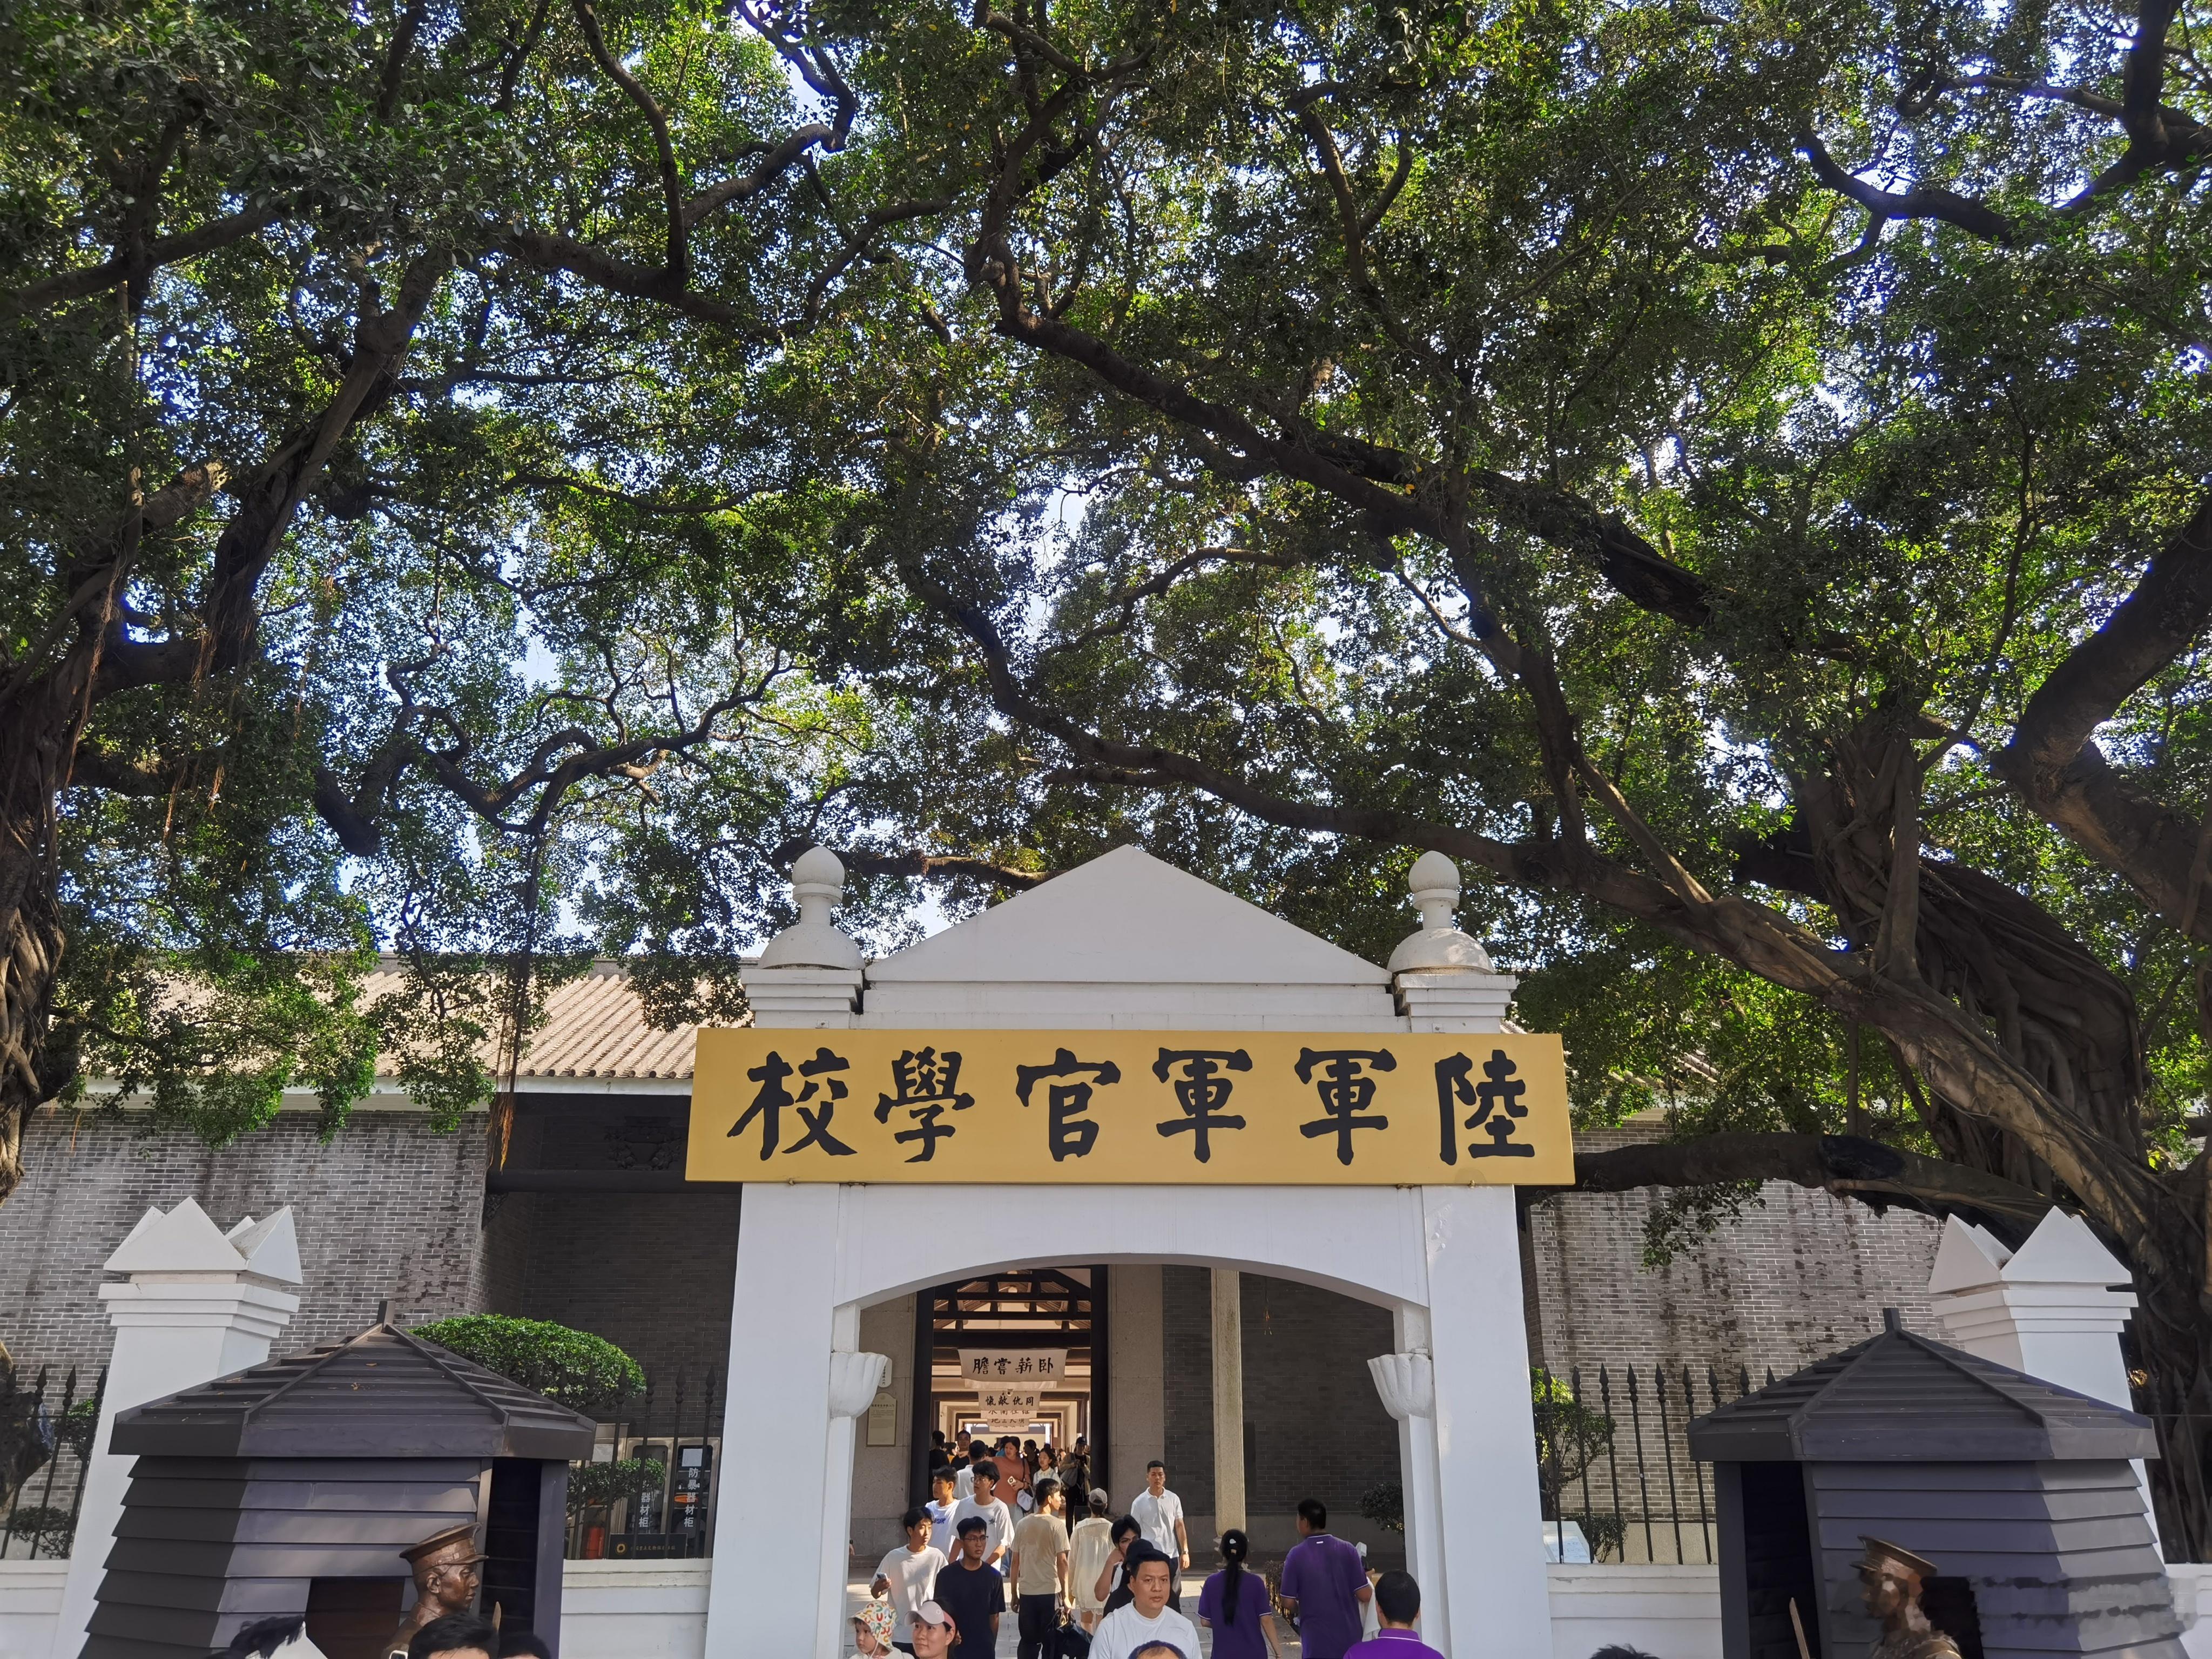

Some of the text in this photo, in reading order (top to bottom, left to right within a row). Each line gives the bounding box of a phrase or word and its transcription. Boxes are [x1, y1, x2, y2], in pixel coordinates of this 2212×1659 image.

[684, 1467, 699, 1528] 防暴器材柜
